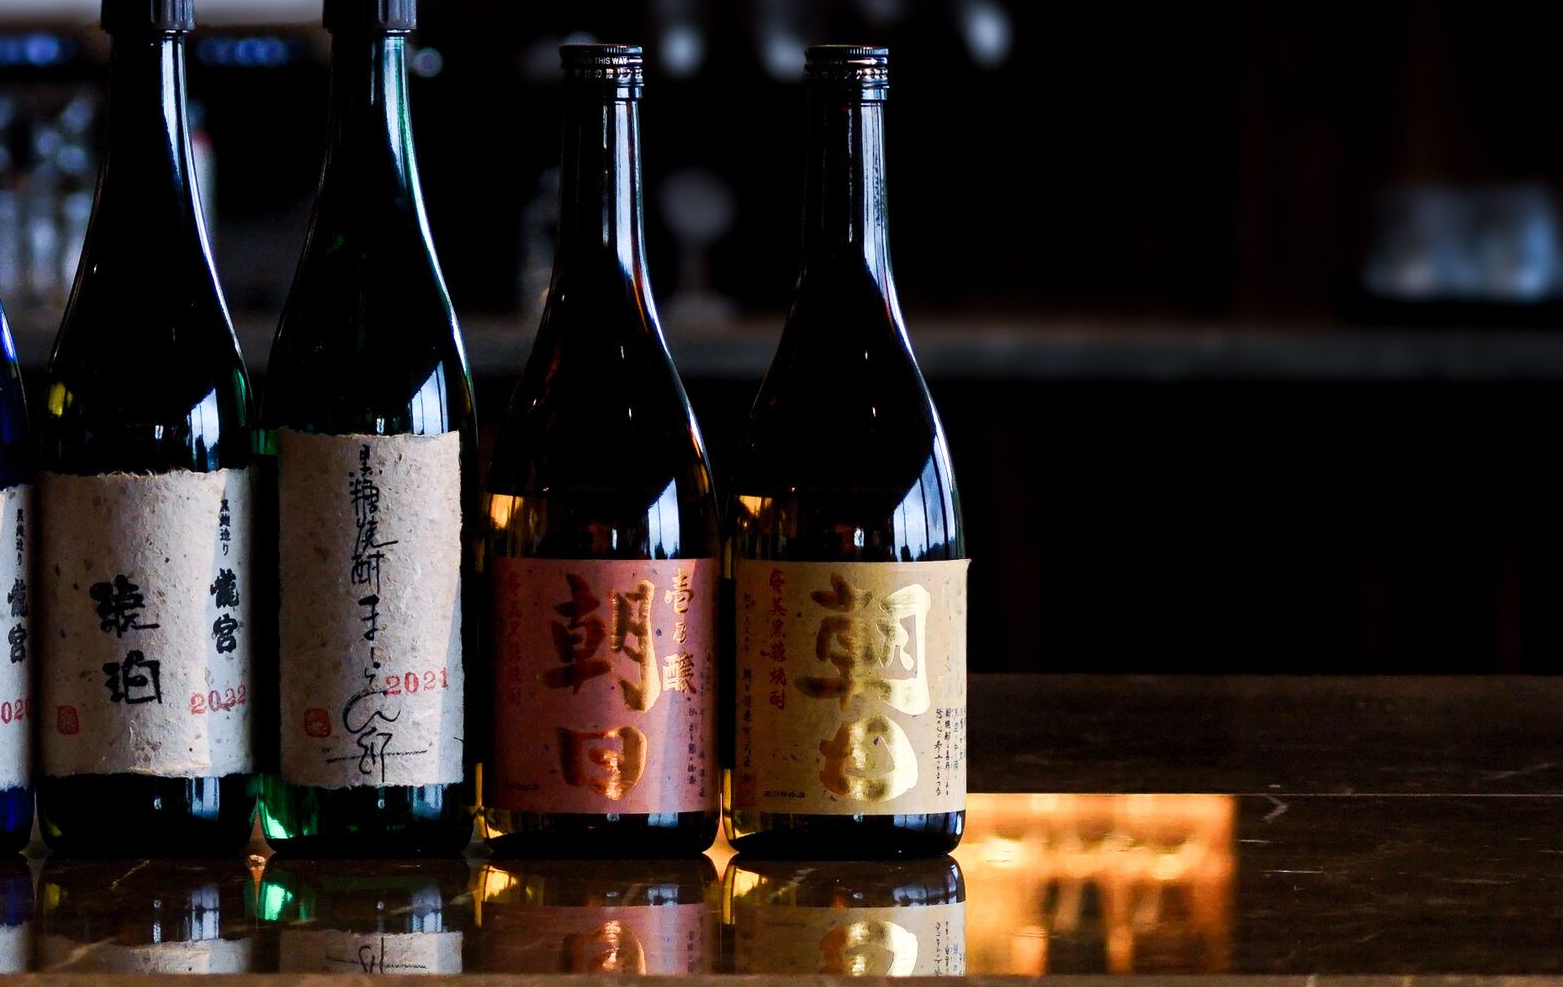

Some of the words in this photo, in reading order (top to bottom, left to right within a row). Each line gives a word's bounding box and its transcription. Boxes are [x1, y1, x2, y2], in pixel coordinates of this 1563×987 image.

[595, 57, 611, 65] THIS
[612, 57, 628, 65] WAY
[385, 667, 448, 696] 2021
